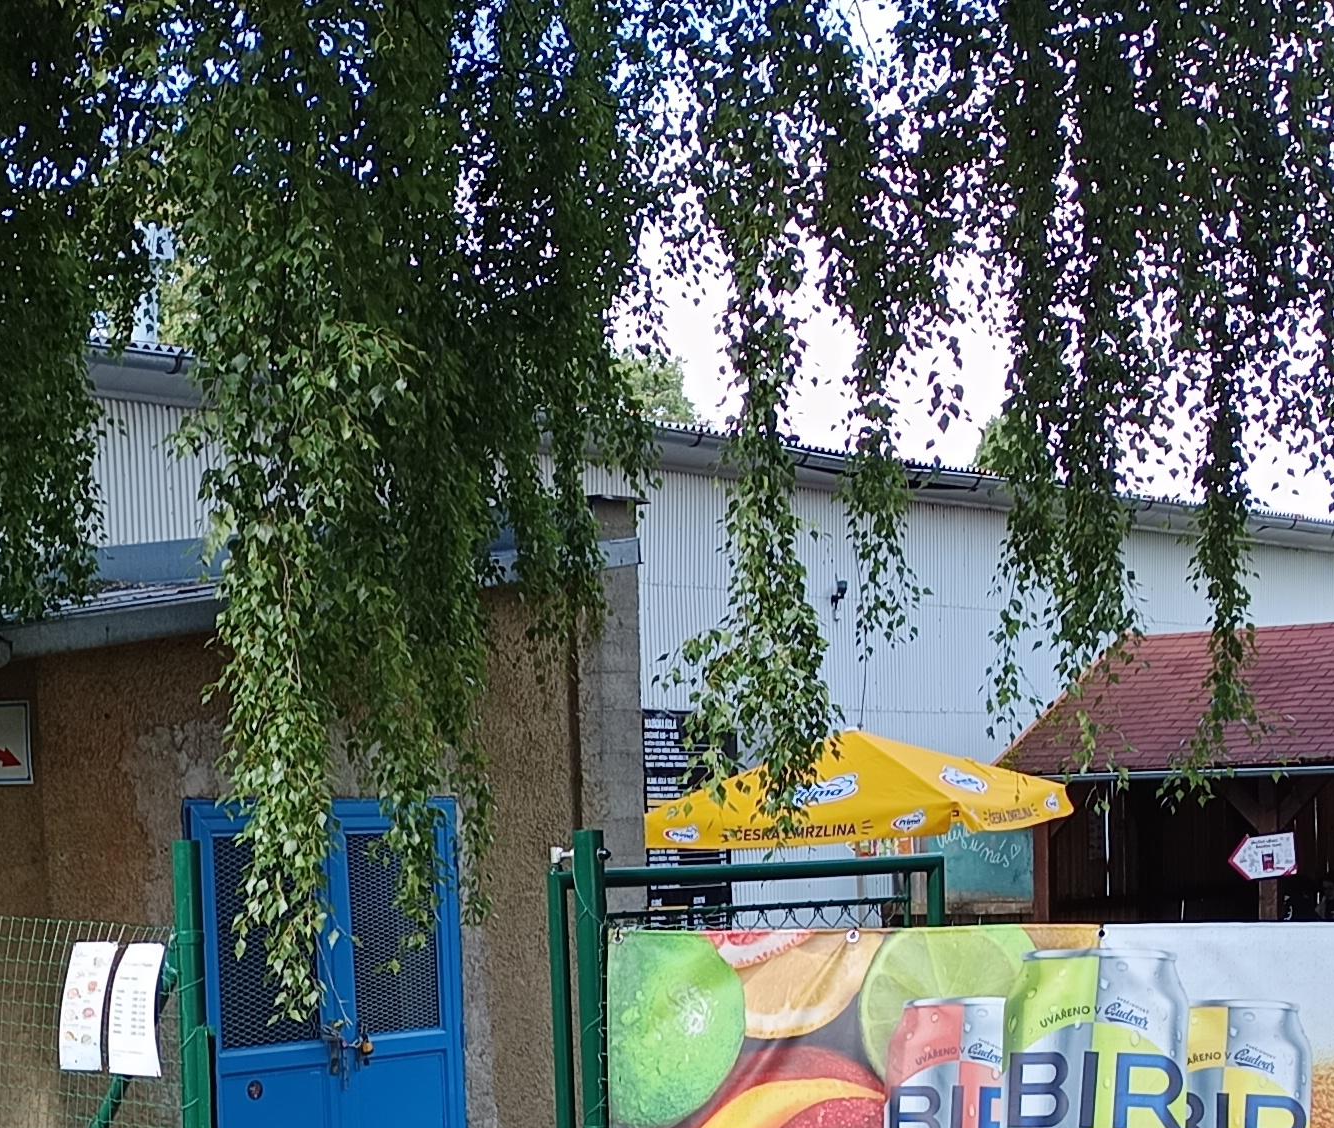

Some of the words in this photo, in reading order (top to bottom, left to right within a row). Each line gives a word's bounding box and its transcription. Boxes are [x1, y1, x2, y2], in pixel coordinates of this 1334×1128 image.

[1040, 1003, 1091, 1028] UVAŘENO
[1094, 1005, 1102, 1016] V
[1187, 1050, 1222, 1067] AŘENO
